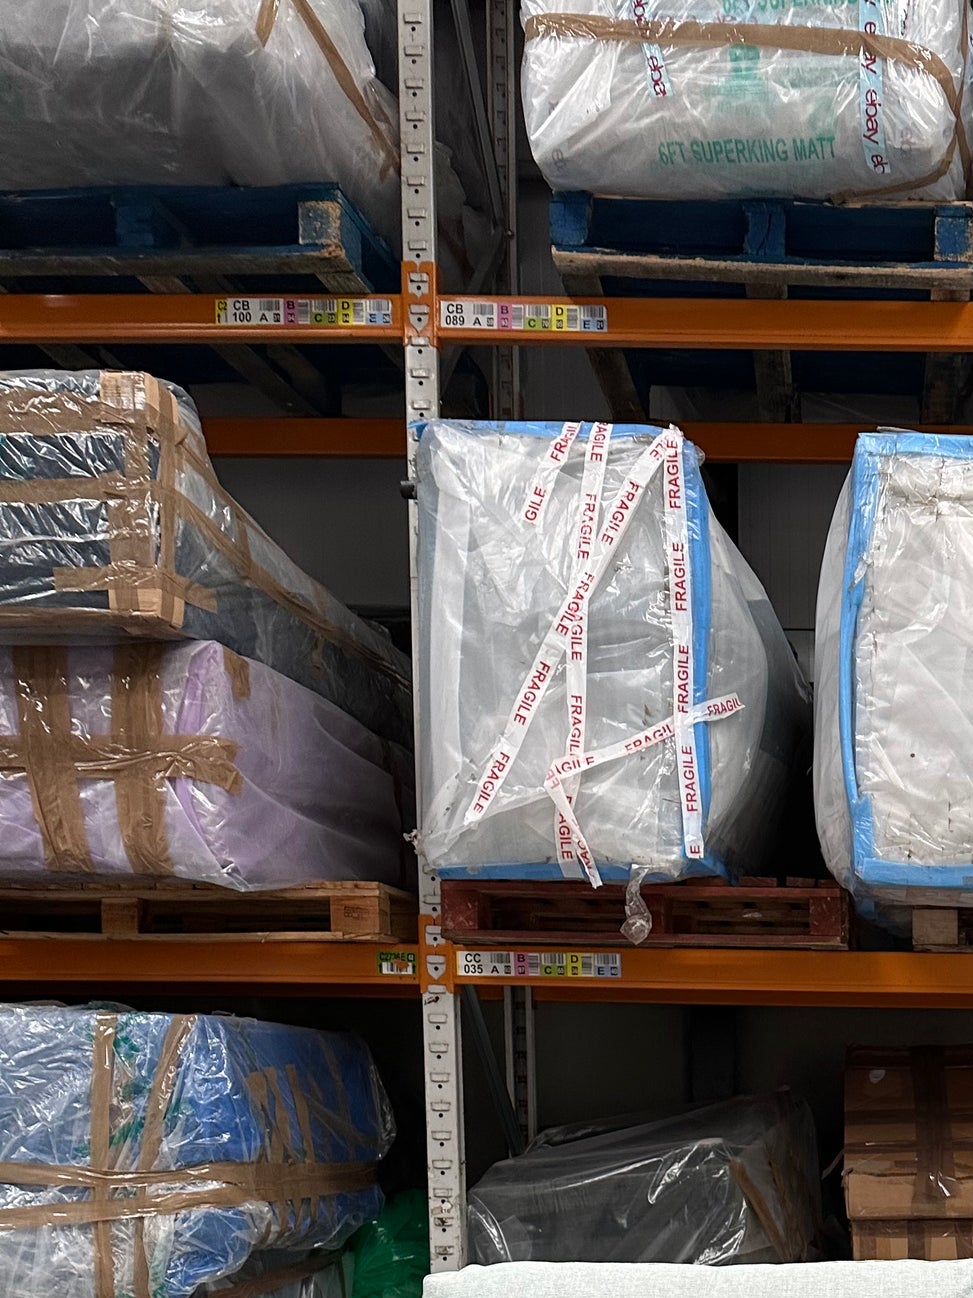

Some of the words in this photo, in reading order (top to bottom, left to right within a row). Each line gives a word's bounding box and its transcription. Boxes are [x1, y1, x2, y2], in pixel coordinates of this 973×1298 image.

[863, 88, 881, 145] ebay
[658, 140, 686, 166] 6FT
[688, 137, 790, 164] SUPERKING
[792, 135, 836, 161] MATT
[233, 300, 250, 311] CB
[287, 301, 295, 310] B
[342, 301, 350, 310] D
[447, 303, 463, 314] CB
[501, 305, 509, 314] B
[556, 307, 564, 316] D
[233, 312, 251, 323] 100
[260, 313, 269, 322] A
[314, 313, 322, 323] C
[445, 315, 465, 326] 089
[473, 317, 481, 326] A
[528, 319, 536, 328] C
[583, 320, 591, 329] E
[667, 440, 682, 509] FRAGILE
[525, 486, 547, 521] GILE
[600, 481, 640, 546] FRAGILE
[577, 493, 597, 560] FRAGILE
[672, 542, 687, 612] FRAGILE
[555, 572, 595, 636] FRAGILE
[677, 645, 690, 713] FRAGILE
[513, 661, 551, 726] FRAGILE
[473, 751, 511, 814] FRAGILE
[682, 745, 698, 812] FRAGILE
[465, 953, 481, 963] CC
[517, 954, 526, 962] B
[570, 954, 578, 963] D
[464, 964, 483, 974] 035
[491, 965, 499, 974] A
[544, 966, 552, 975] C
[597, 967, 605, 976] E
